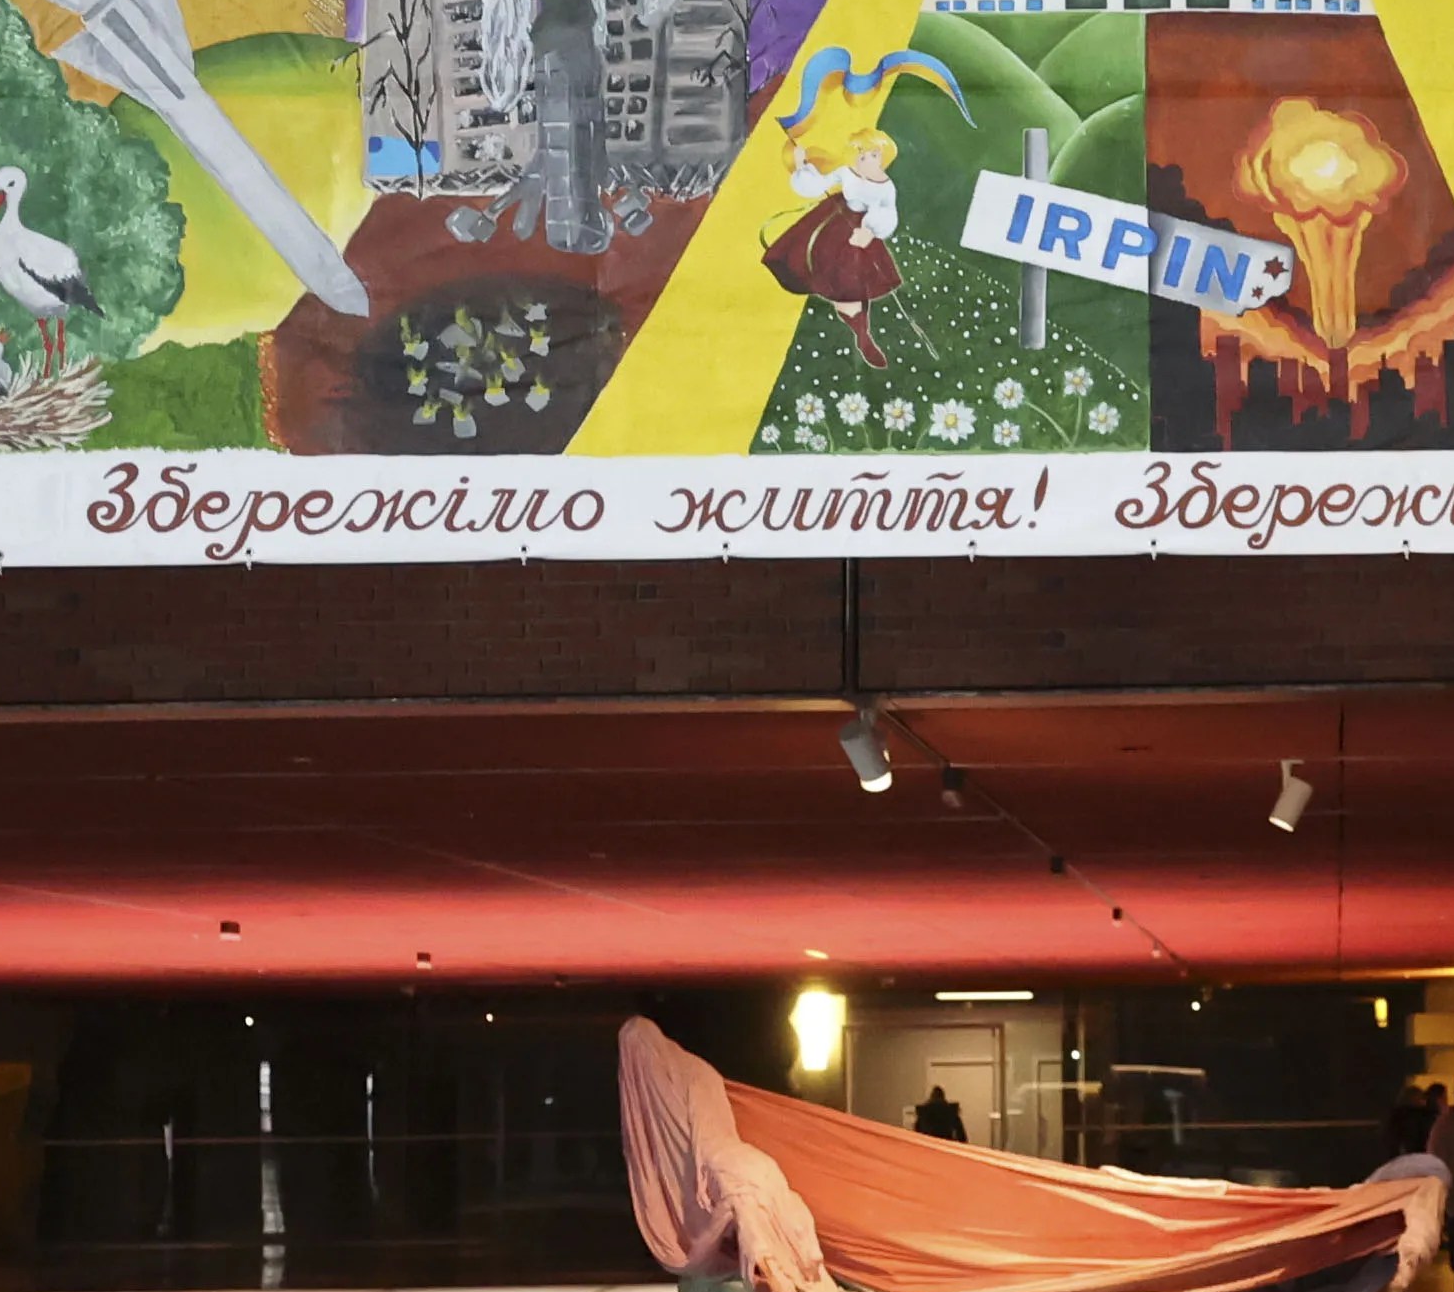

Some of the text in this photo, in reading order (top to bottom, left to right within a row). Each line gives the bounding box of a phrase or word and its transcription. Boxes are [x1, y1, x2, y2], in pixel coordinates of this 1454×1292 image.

[1006, 194, 1251, 302] IRPIN
[87, 462, 604, 561] Збережімо
[661, 464, 1051, 533] життя!
